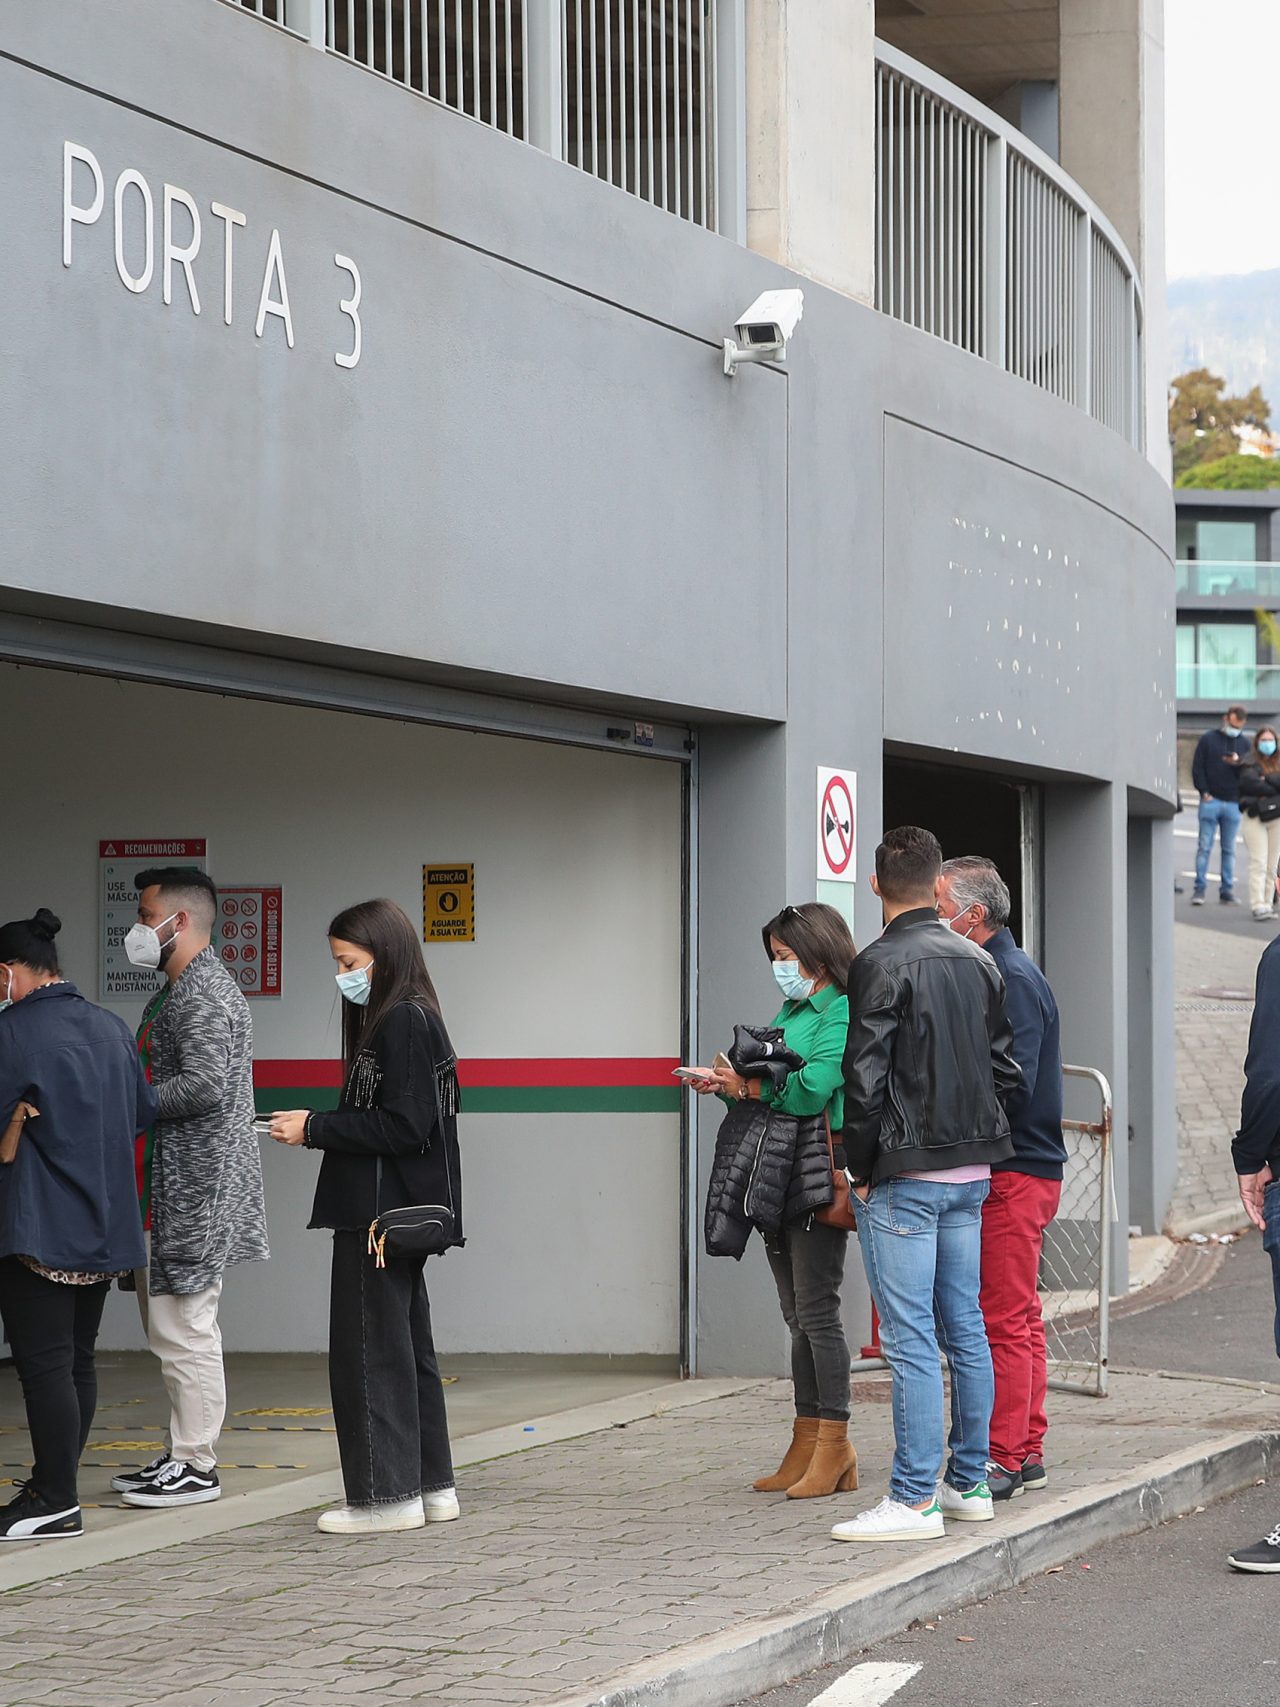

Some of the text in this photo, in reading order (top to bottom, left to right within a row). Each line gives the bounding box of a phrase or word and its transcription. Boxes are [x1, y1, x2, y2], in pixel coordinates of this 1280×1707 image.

[63, 140, 362, 369] PORTA 3
[124, 843, 186, 855] RECOMENDAÇÕES
[430, 872, 465, 884] ATENÇÃO
[107, 881, 126, 891] USE
[107, 891, 140, 902] MÁSCA
[431, 919, 467, 928] AGUARDE
[452, 928, 467, 936] VEZ
[266, 952, 278, 987] OBJETOS
[106, 972, 157, 981] MANTENHA
[107, 981, 161, 992] A DISTÂNCIA
